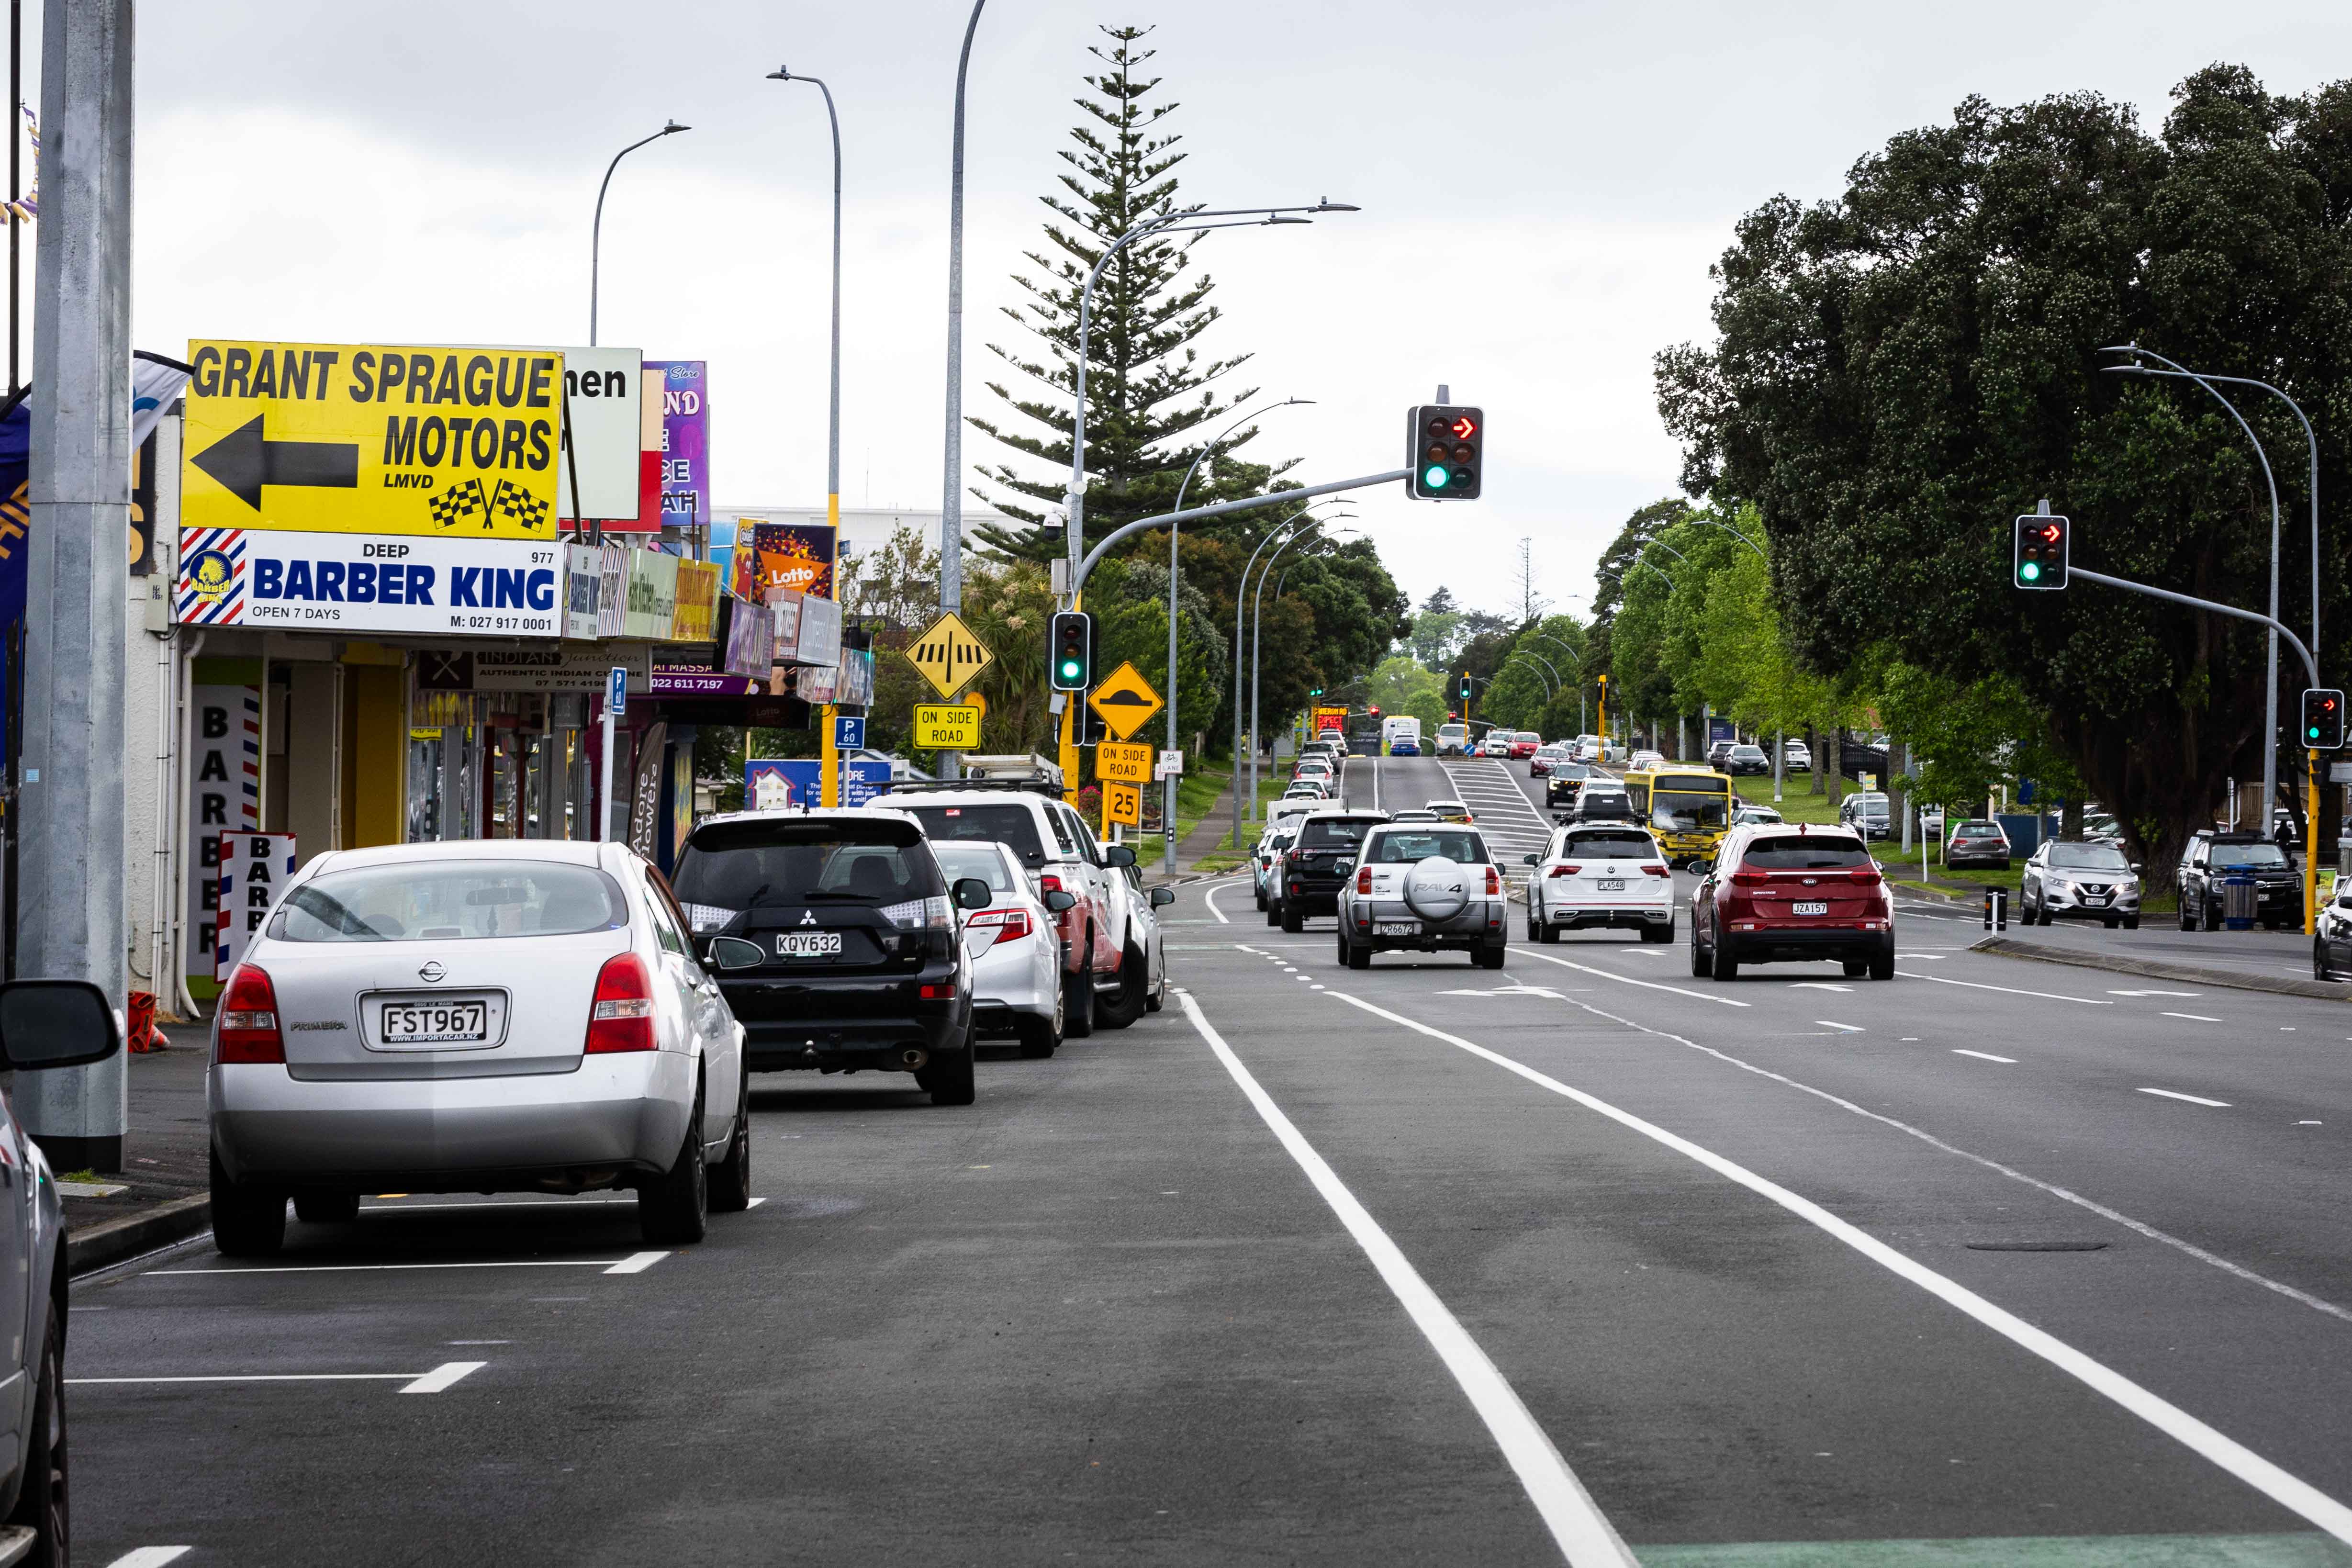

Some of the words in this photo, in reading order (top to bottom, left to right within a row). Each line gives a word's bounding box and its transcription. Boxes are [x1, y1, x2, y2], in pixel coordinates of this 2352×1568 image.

[192, 346, 339, 399] GRANT
[349, 351, 554, 408] SPRAGUE
[670, 366, 699, 379] Store
[383, 415, 551, 471] MOTORS
[383, 474, 434, 489] LMVD
[362, 543, 410, 558] DEEP
[531, 552, 554, 563] 977
[772, 568, 814, 584] Lotto
[191, 577, 230, 593] BARBER
[253, 559, 435, 606] BARBER
[450, 567, 554, 611] KING
[253, 606, 290, 618] OPEN
[294, 606, 301, 617] 7
[305, 607, 340, 620] DAYS
[450, 616, 466, 627] M:
[470, 616, 492, 628] 027
[496, 617, 518, 629] 917
[523, 618, 552, 630] 0001
[616, 672, 623, 689] P
[652, 679, 672, 688] 022
[674, 680, 694, 688] 611
[696, 680, 723, 689] 7197
[922, 712, 939, 724] ON
[947, 712, 972, 724] SIDE
[845, 720, 855, 732] P
[843, 732, 855, 742] 60
[932, 730, 963, 742] ROAD
[1103, 749, 1119, 759] ON
[1122, 750, 1145, 762] SIDE
[1110, 763, 1137, 775] ROAD
[641, 763, 658, 857] lowers
[1114, 792, 1134, 816] 25
[633, 773, 649, 857] Adore
[200, 706, 230, 954] BARBER
[1413, 884, 1463, 893] RAV4
[1794, 904, 1826, 912] JZA157
[778, 935, 840, 952] KQY632
[291, 1021, 347, 1031] PRIMERA
[387, 1009, 480, 1035] FST967
[390, 1033, 478, 1042] WWW.IMPORTACAR.NZ
